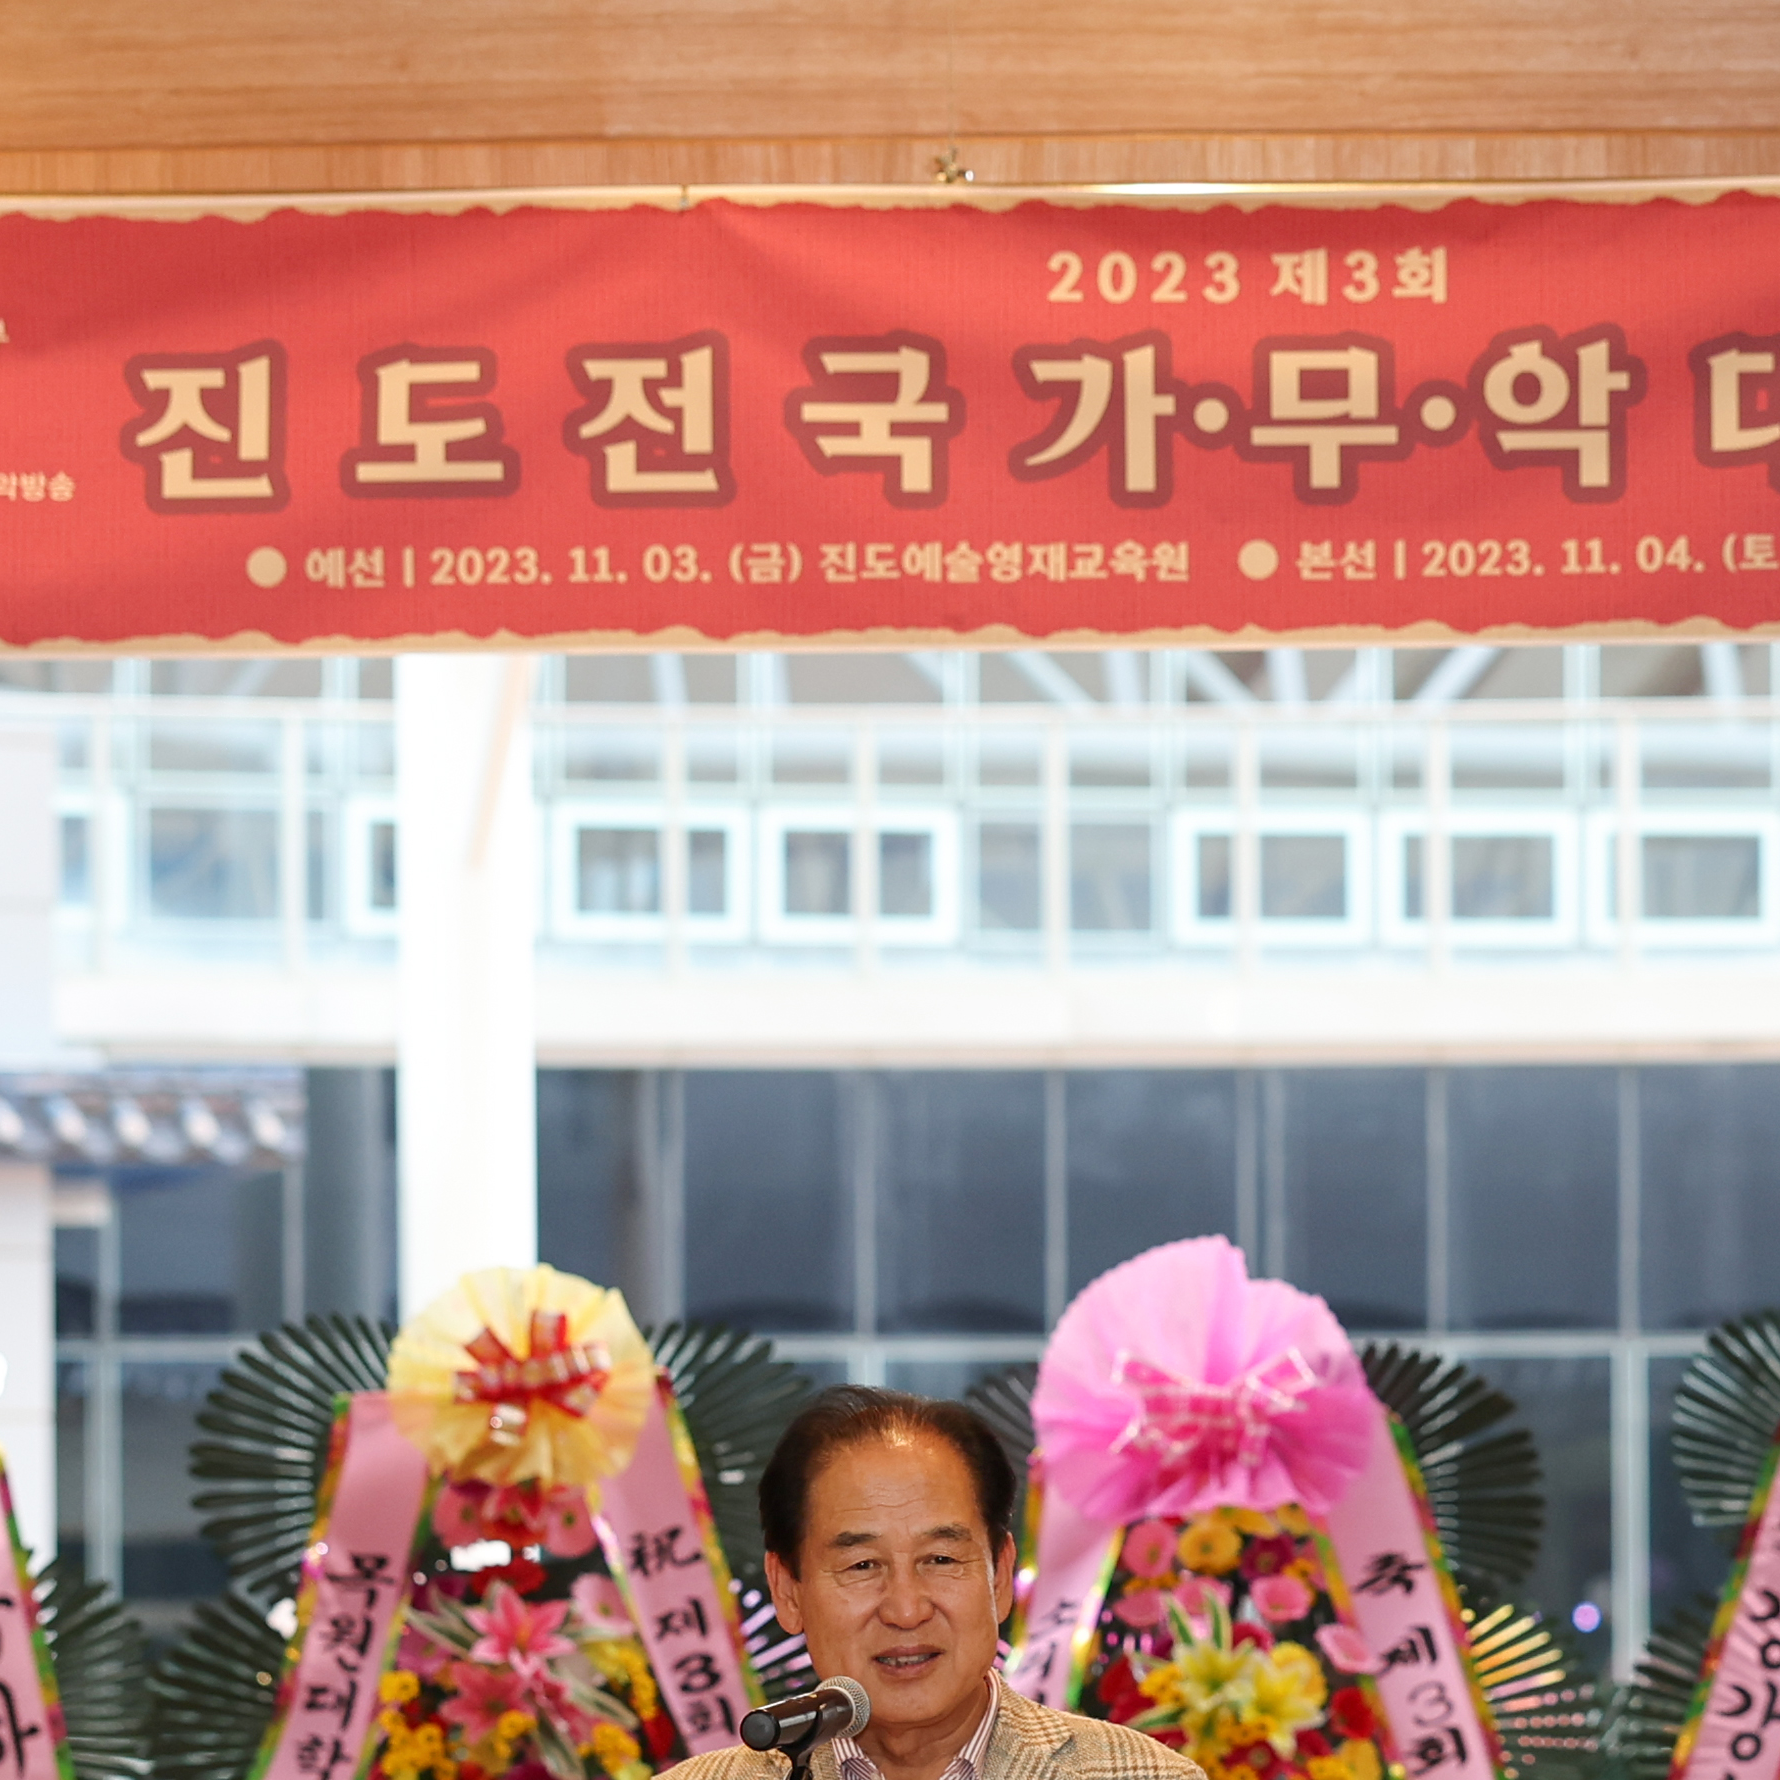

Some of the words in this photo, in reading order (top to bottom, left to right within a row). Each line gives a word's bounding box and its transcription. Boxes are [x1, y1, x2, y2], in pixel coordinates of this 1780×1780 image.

[1047, 251, 1240, 304] 2023
[1270, 247, 1447, 306] 제3회
[305, 547, 384, 588] 예선
[431, 547, 552, 585] 2023.
[569, 547, 627, 583] 11.
[643, 545, 711, 582] 03.
[729, 543, 802, 583] (금)
[821, 540, 1188, 583] 진도예술영재교육원
[1297, 540, 1376, 580] 본선
[1422, 540, 1544, 576] 2023.
[1562, 538, 1620, 574] 11.
[1636, 536, 1704, 572] 04.
